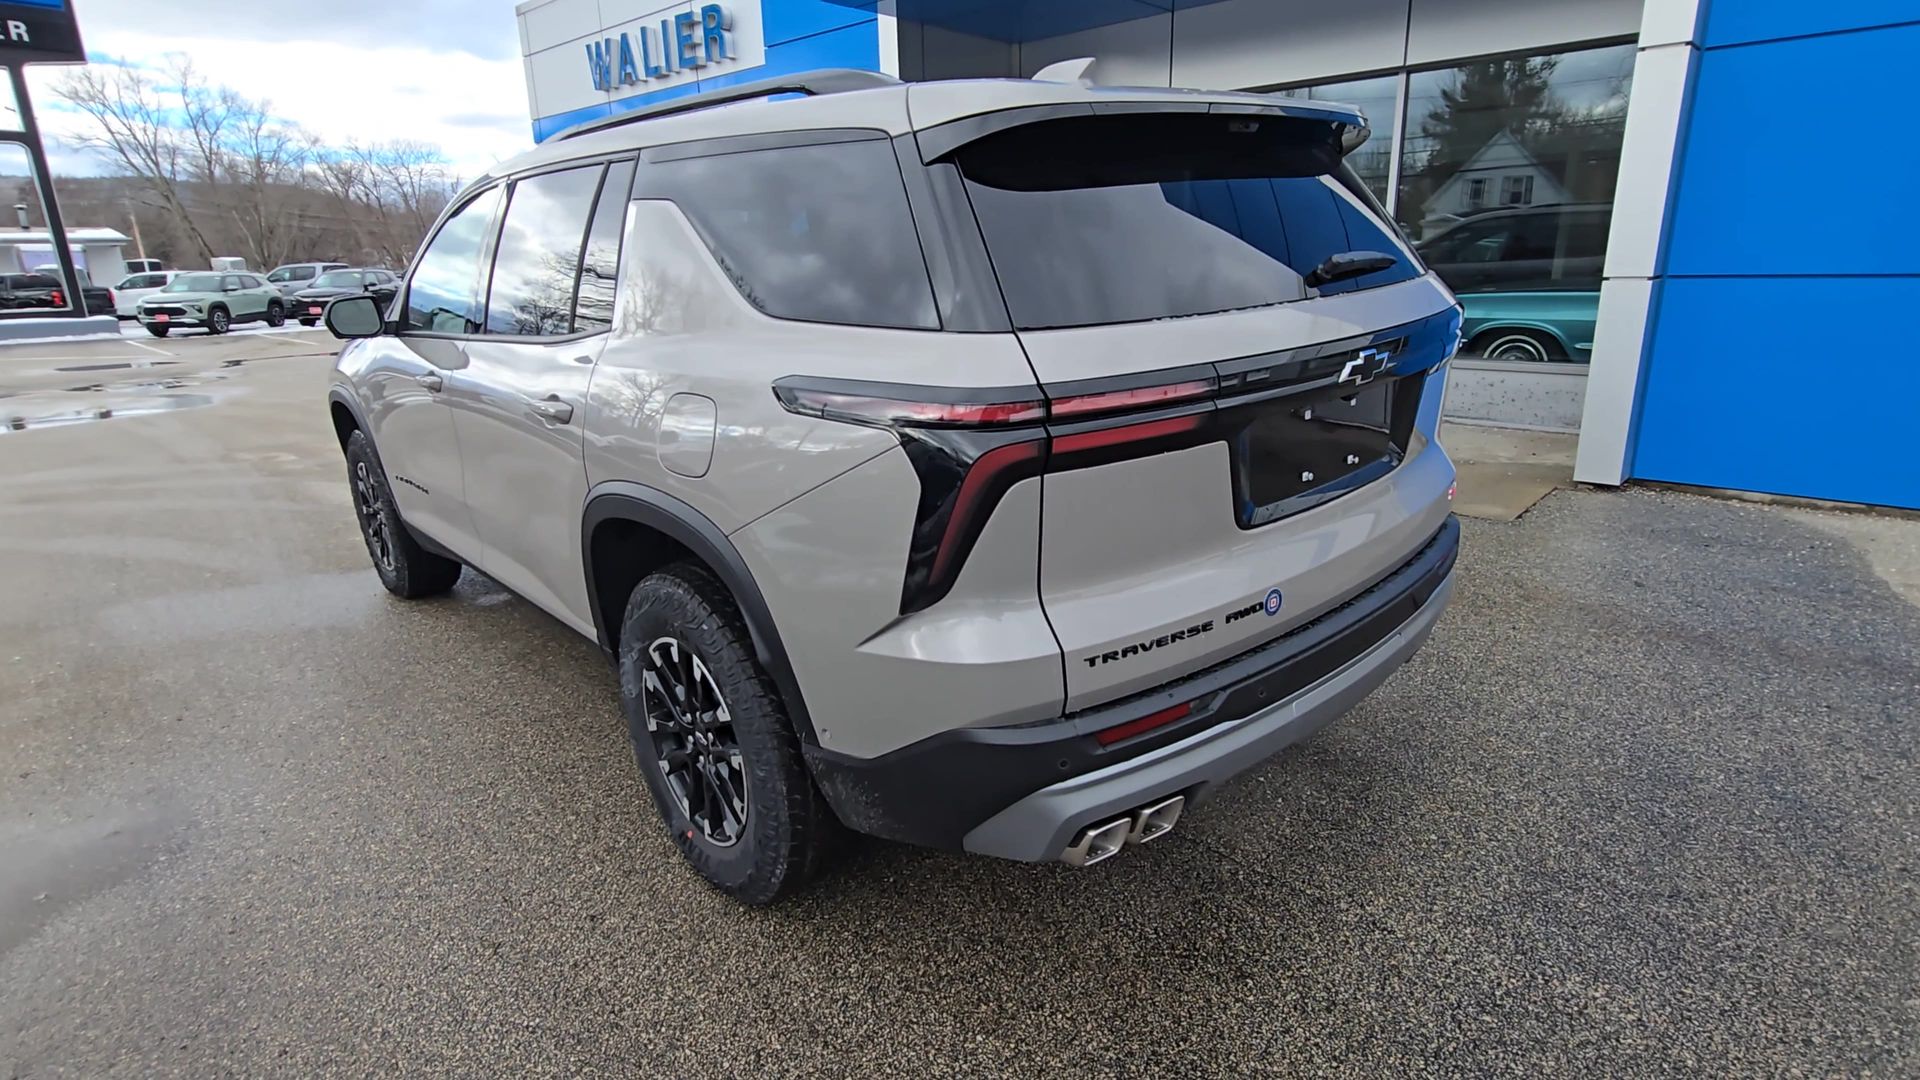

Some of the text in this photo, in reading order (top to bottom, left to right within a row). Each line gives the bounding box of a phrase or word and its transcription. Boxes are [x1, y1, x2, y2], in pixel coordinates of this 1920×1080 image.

[585, 3, 734, 92] WALIER
[1083, 620, 1214, 668] TRAVERSE
[1225, 601, 1265, 624] AWD
